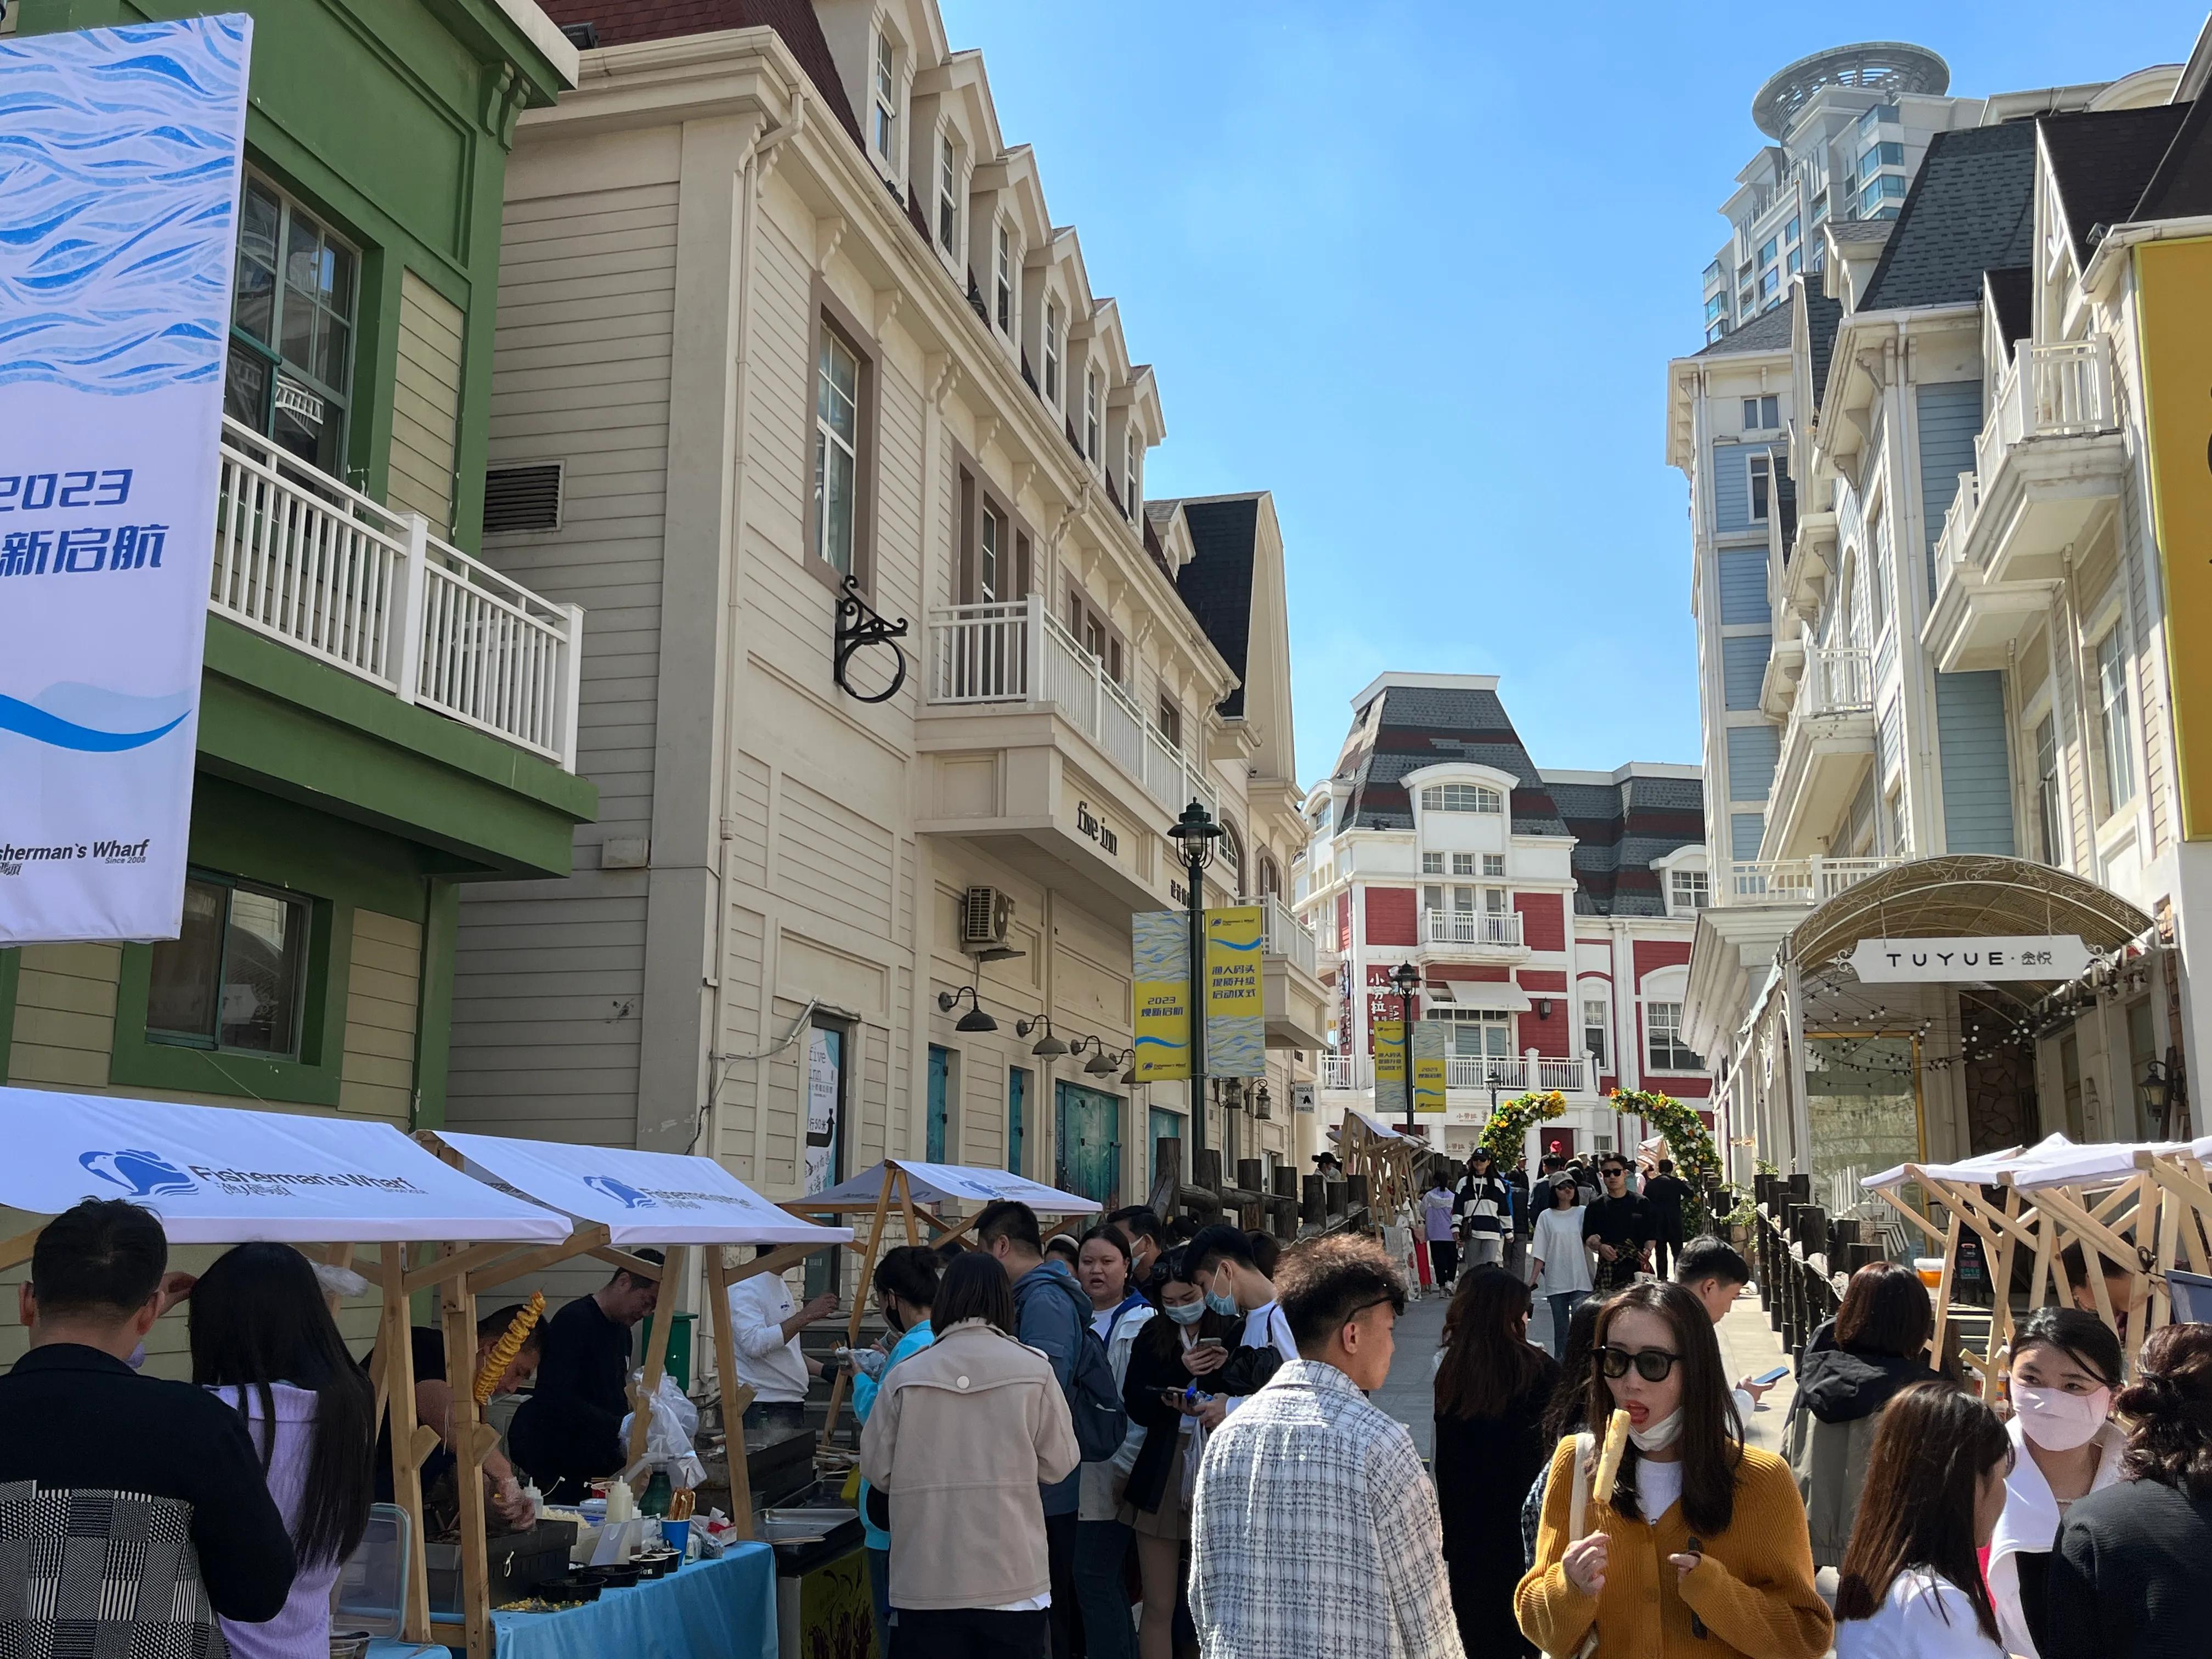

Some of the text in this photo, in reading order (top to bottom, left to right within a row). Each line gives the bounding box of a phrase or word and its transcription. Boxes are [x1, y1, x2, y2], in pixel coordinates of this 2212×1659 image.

[0, 469, 133, 512] 2023
[0, 524, 170, 577] 新启航
[1077, 801, 1118, 856] five inn
[93, 839, 150, 857] Wharf
[1212, 964, 1255, 975] 渔人码头
[1212, 976, 1256, 987] 提质升级
[1148, 996, 1176, 1005] 2023
[1212, 989, 1256, 1000] 启动仪式
[809, 1046, 826, 1064] five
[338, 1173, 416, 1189] Wharf
